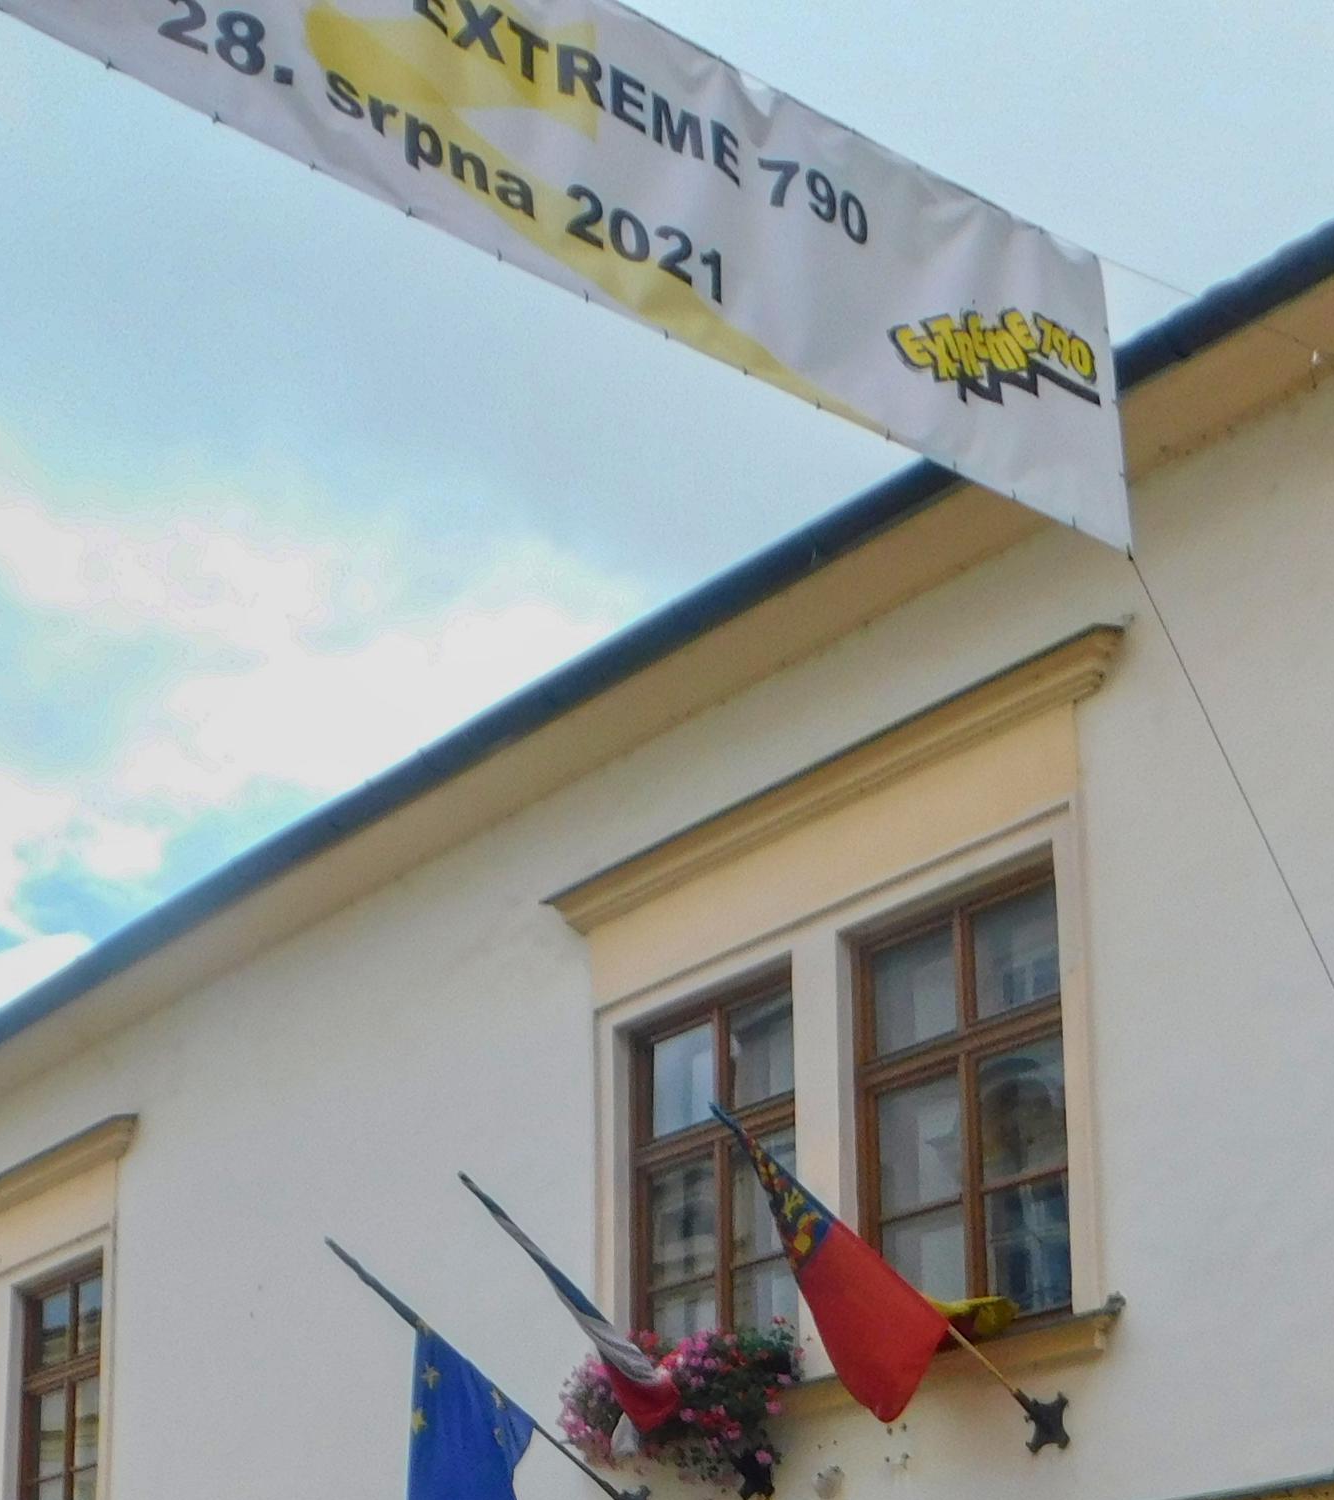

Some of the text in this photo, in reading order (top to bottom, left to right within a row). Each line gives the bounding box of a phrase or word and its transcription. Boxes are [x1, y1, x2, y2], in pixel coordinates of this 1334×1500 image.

[157, 0, 723, 304] 28. srpna 2021
[757, 157, 868, 245] 790
[889, 308, 1097, 382] EXTREME 790
